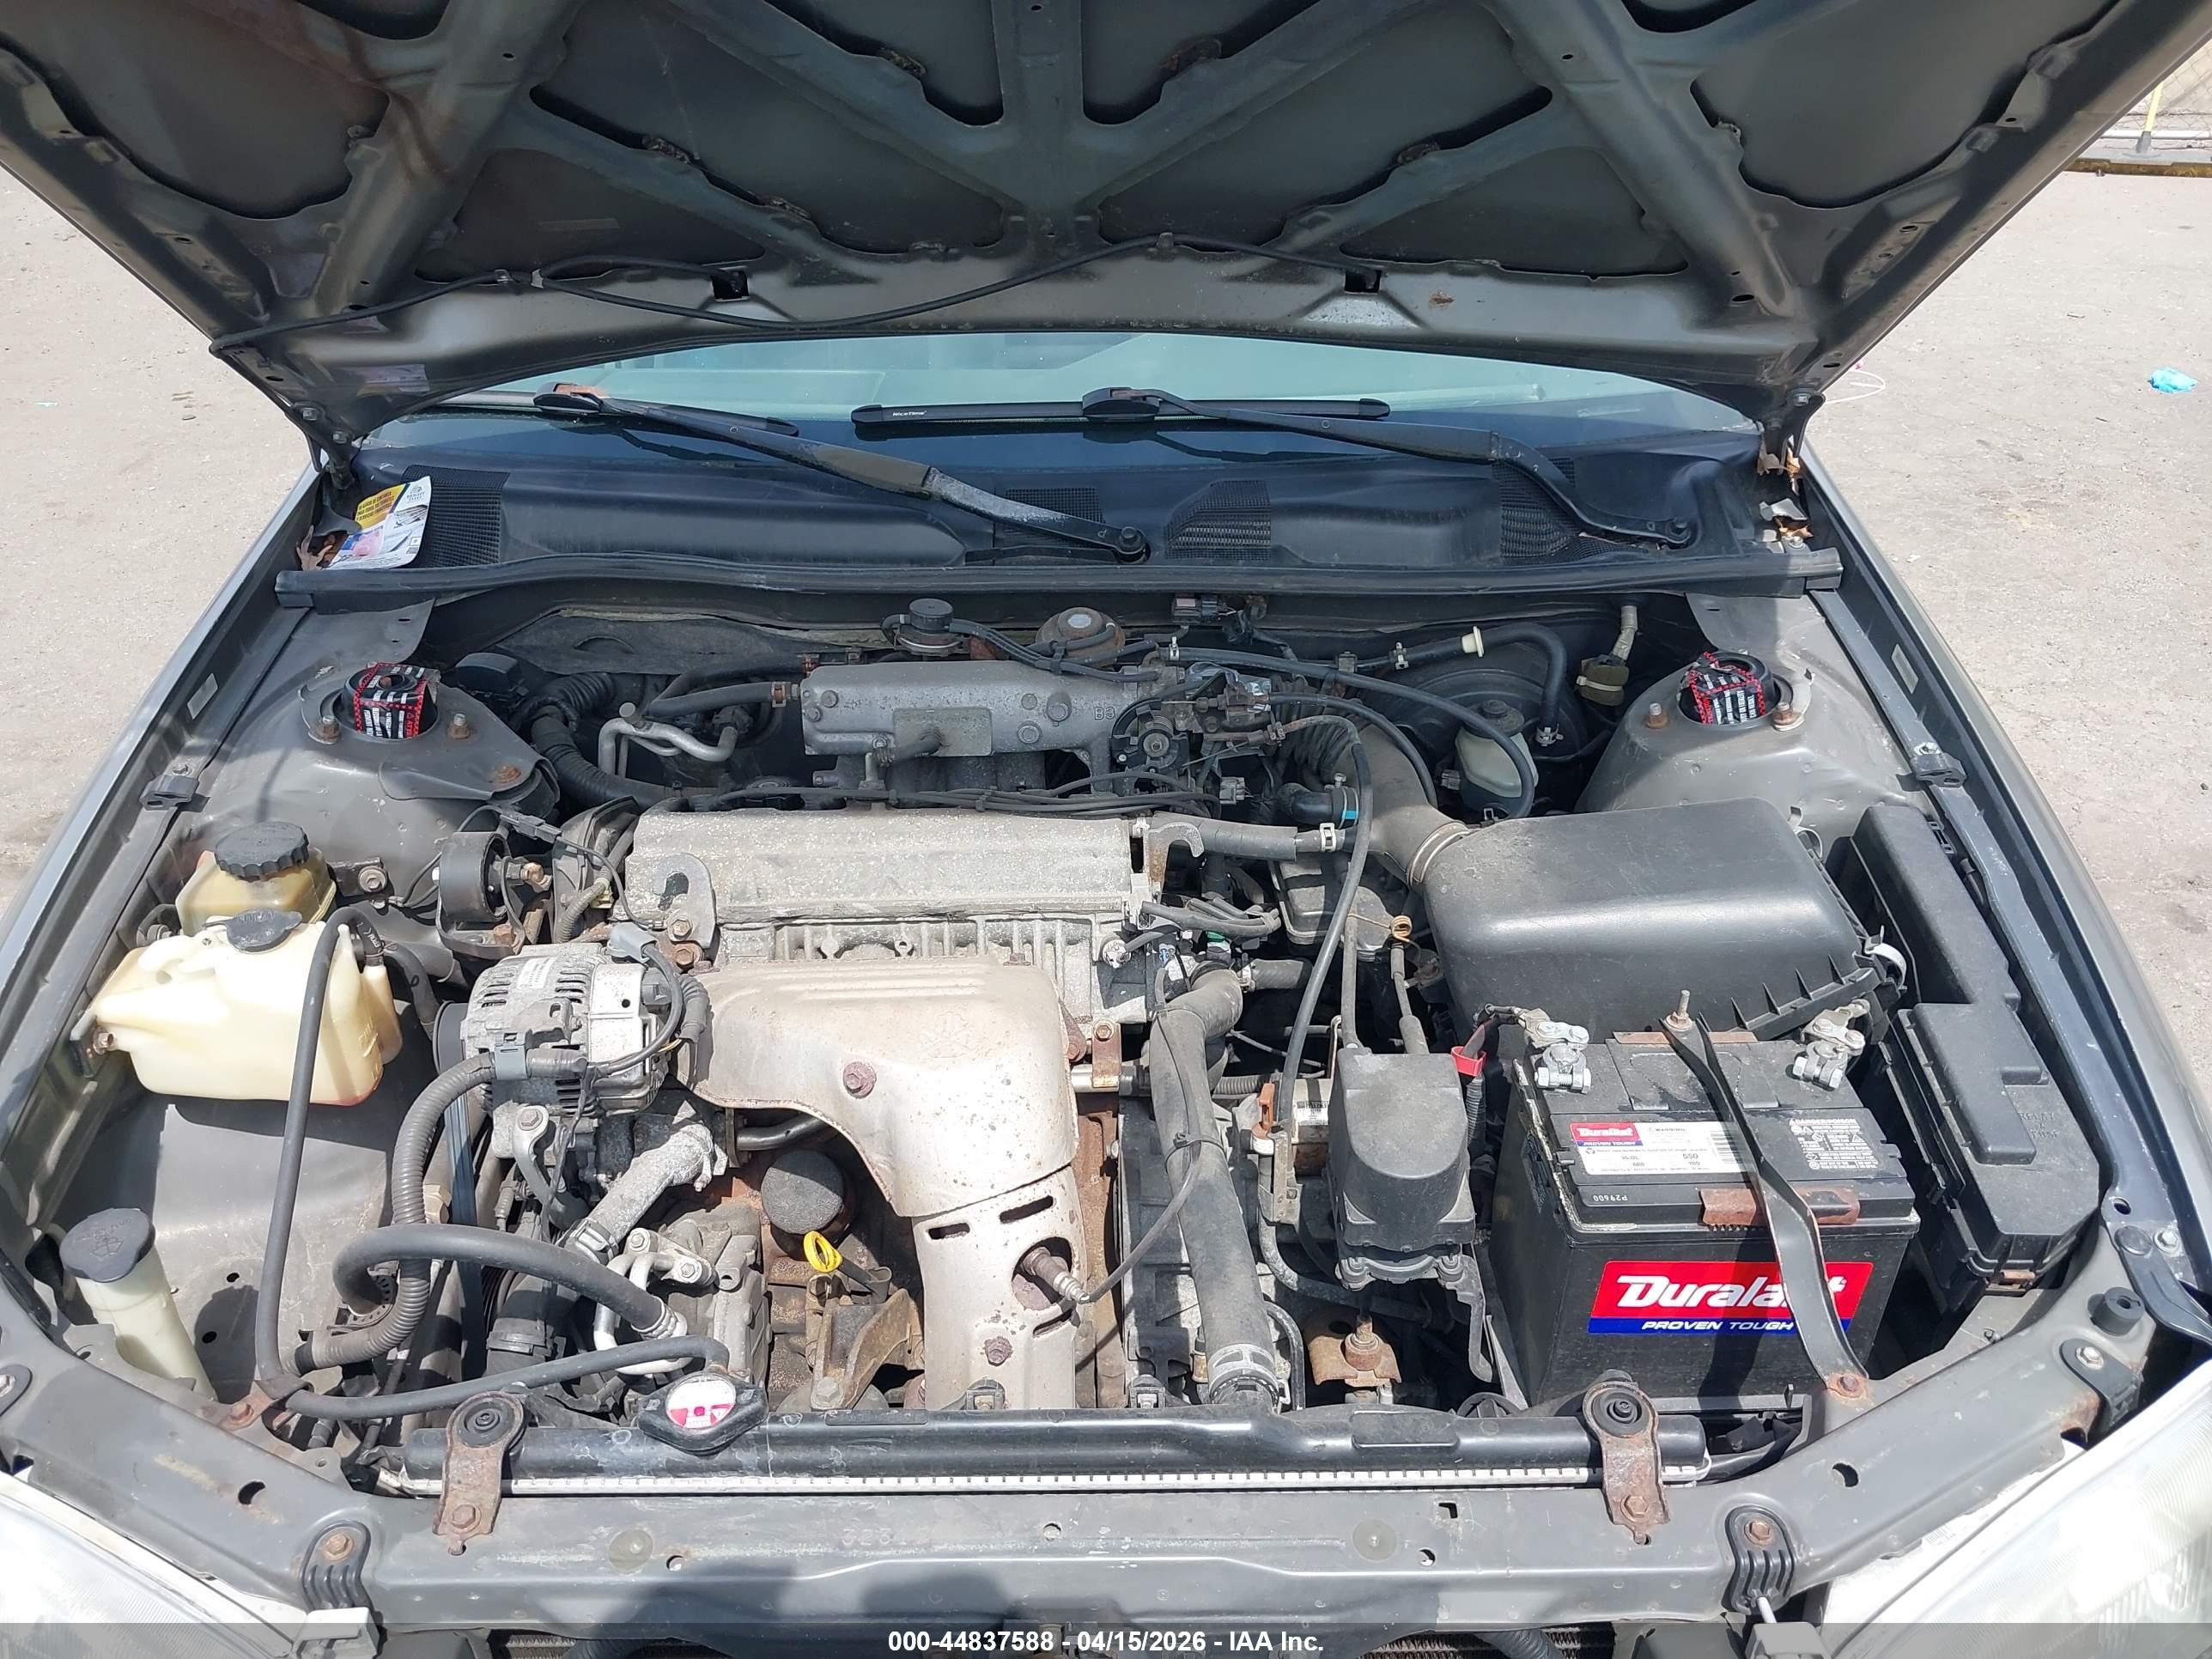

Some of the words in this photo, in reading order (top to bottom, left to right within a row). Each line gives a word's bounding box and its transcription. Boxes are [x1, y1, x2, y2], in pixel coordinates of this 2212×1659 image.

[1617, 1275, 1846, 1308] Duralat
[1641, 1321, 1723, 1330] PROVEN
[1729, 1321, 1794, 1330] TOUGH
